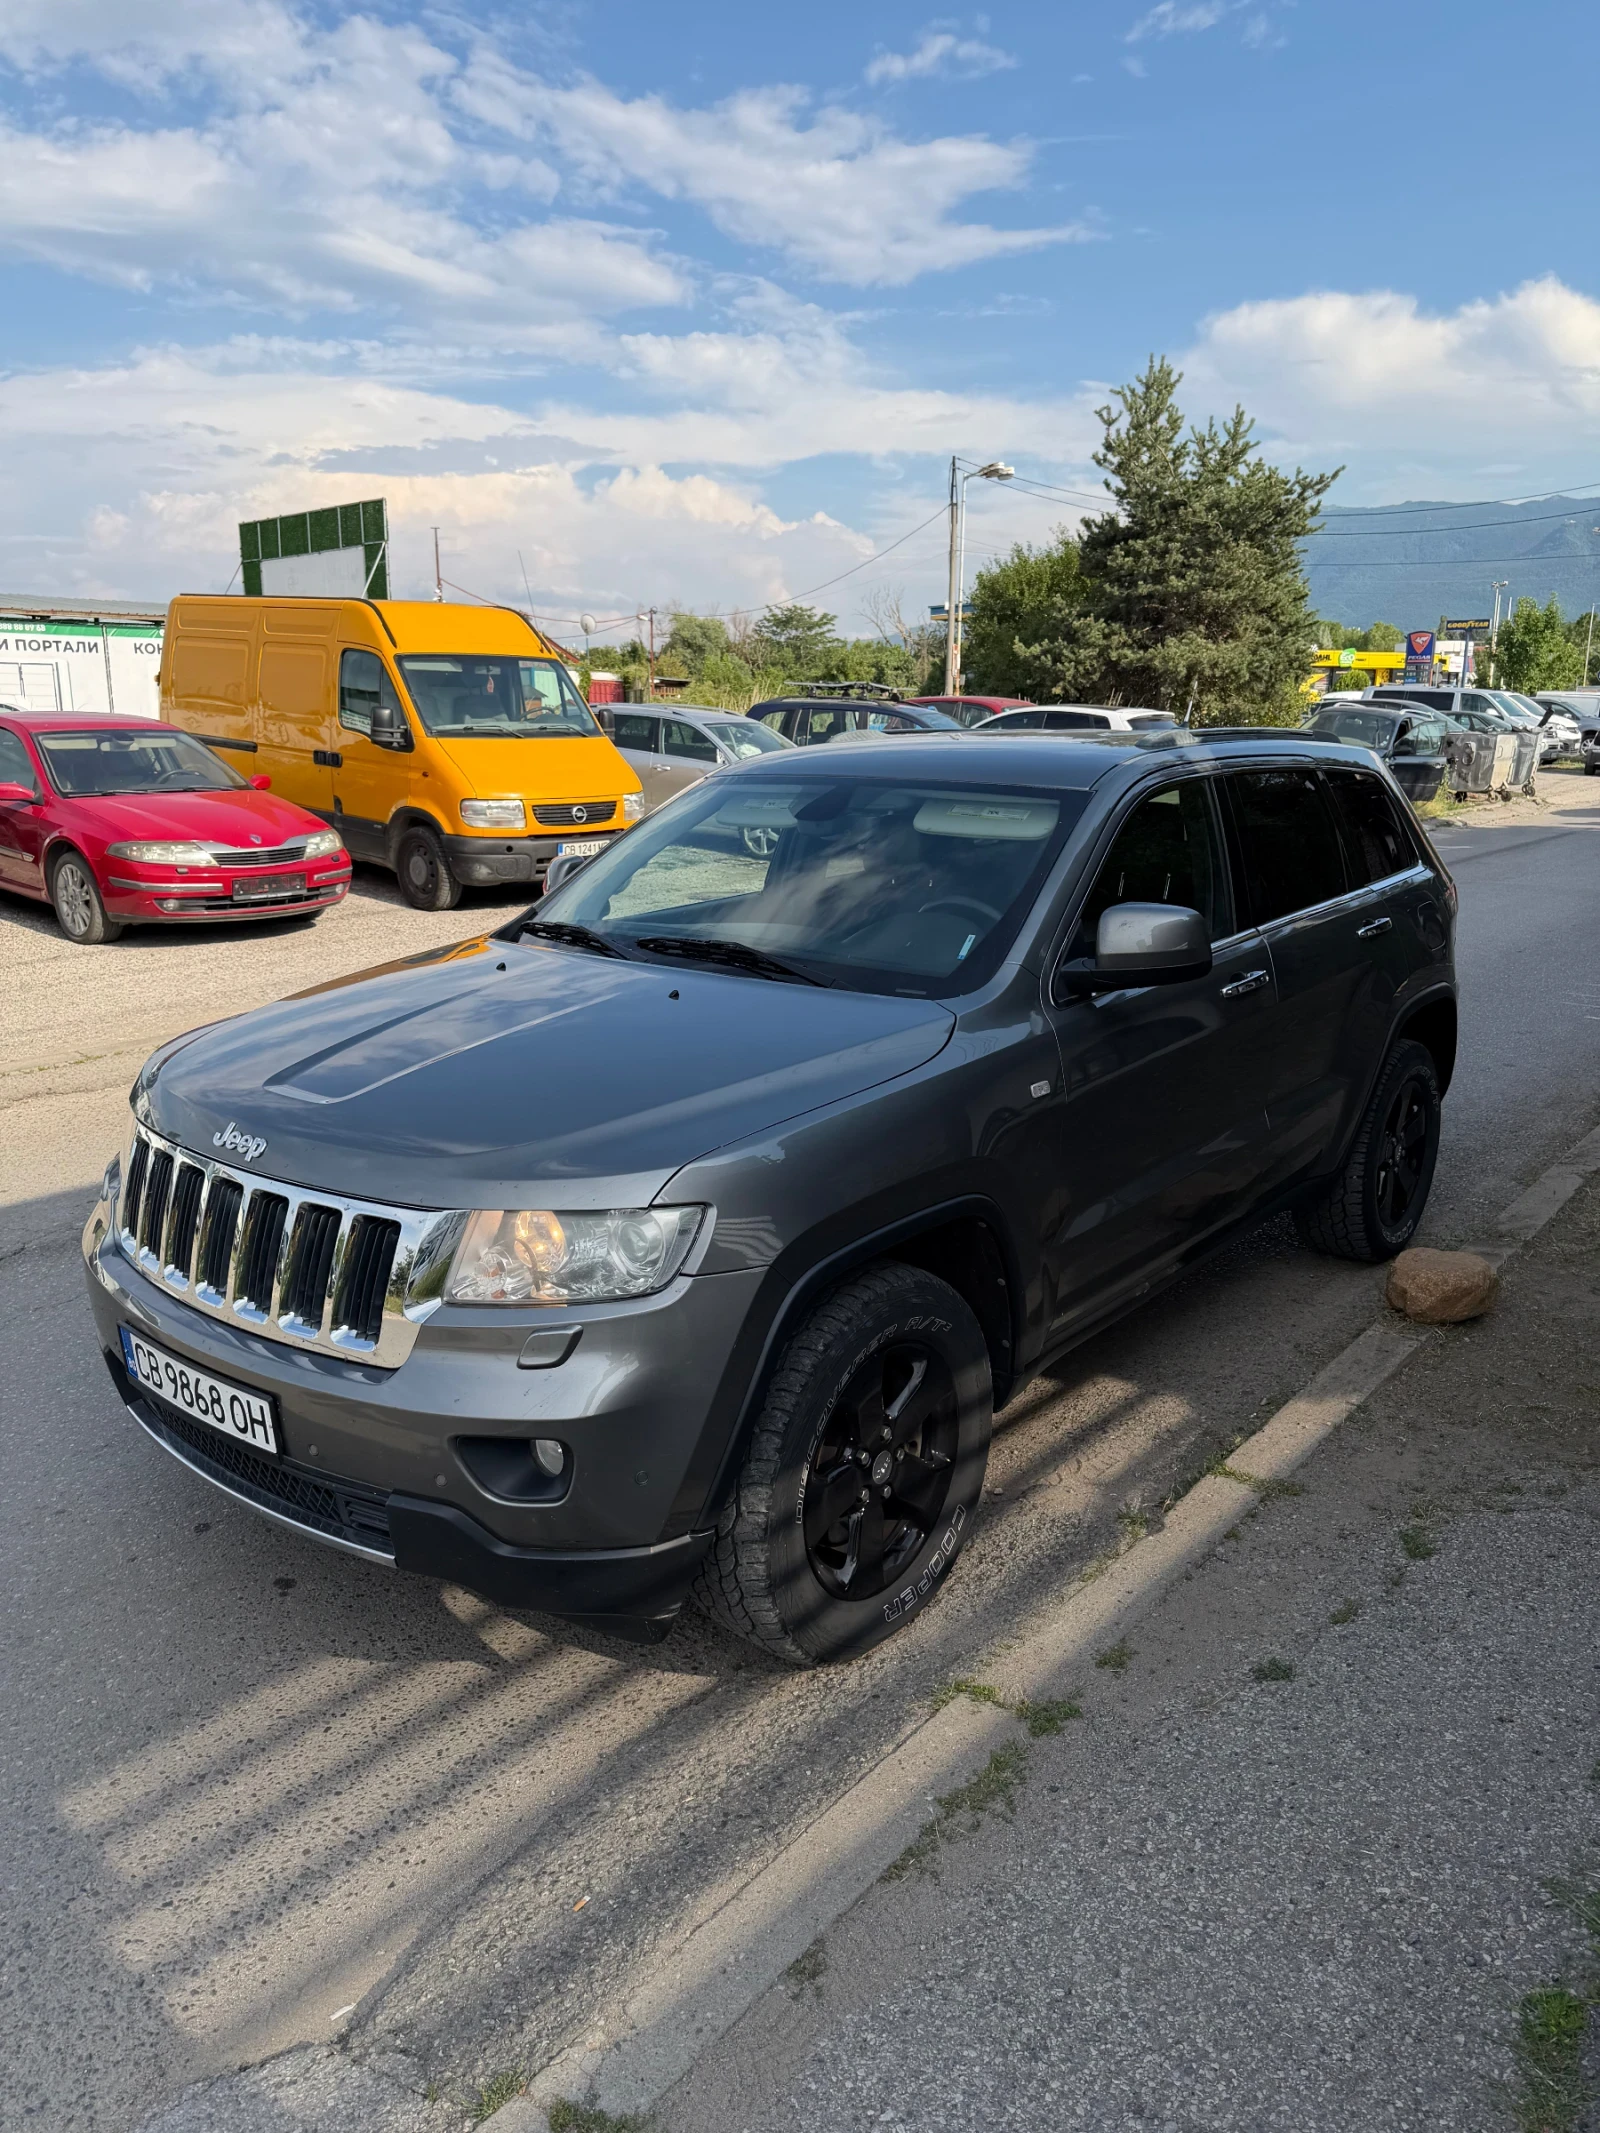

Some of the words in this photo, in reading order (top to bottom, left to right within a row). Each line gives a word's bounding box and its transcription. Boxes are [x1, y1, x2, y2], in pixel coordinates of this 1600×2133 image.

[1447, 620, 1489, 630] GOODYEAR
[15, 638, 99, 654] ПОРТАЛИ
[564, 844, 576, 856] CB
[578, 842, 597, 855] 1241
[212, 1121, 268, 1161] Jeep
[134, 1342, 163, 1390] CB
[164, 1361, 226, 1424] 9868
[230, 1394, 270, 1445] OH
[883, 1503, 967, 1622] COOPER
